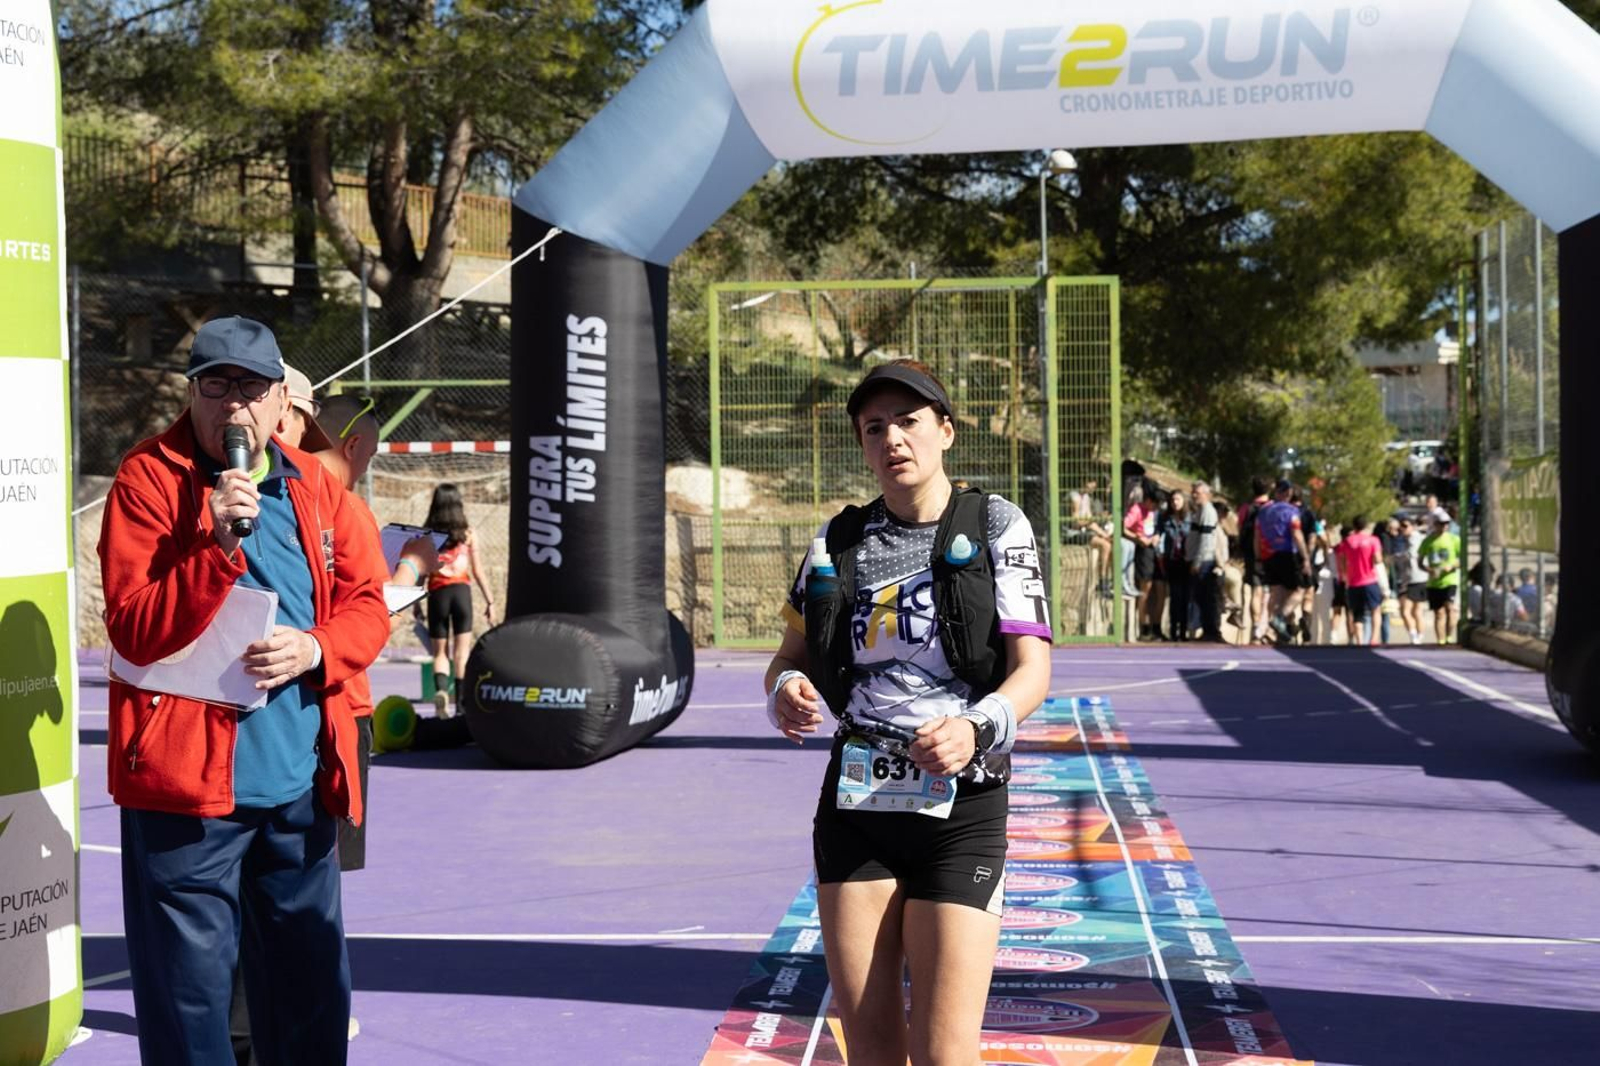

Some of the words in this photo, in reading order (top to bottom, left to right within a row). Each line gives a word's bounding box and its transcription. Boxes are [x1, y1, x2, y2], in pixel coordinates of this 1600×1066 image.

[1059, 87, 1227, 114] CRONOMETRAJE
[1233, 79, 1355, 105] DEPORTIVO
[0, 239, 51, 262] RTES
[557, 314, 608, 452] LÍMITES
[566, 455, 596, 503] TUS
[528, 435, 563, 569] SUPERA
[481, 684, 587, 703] TIME2RUN
[1, 879, 68, 914] PUTACIÓN
[9, 912, 48, 939] JAÉN
